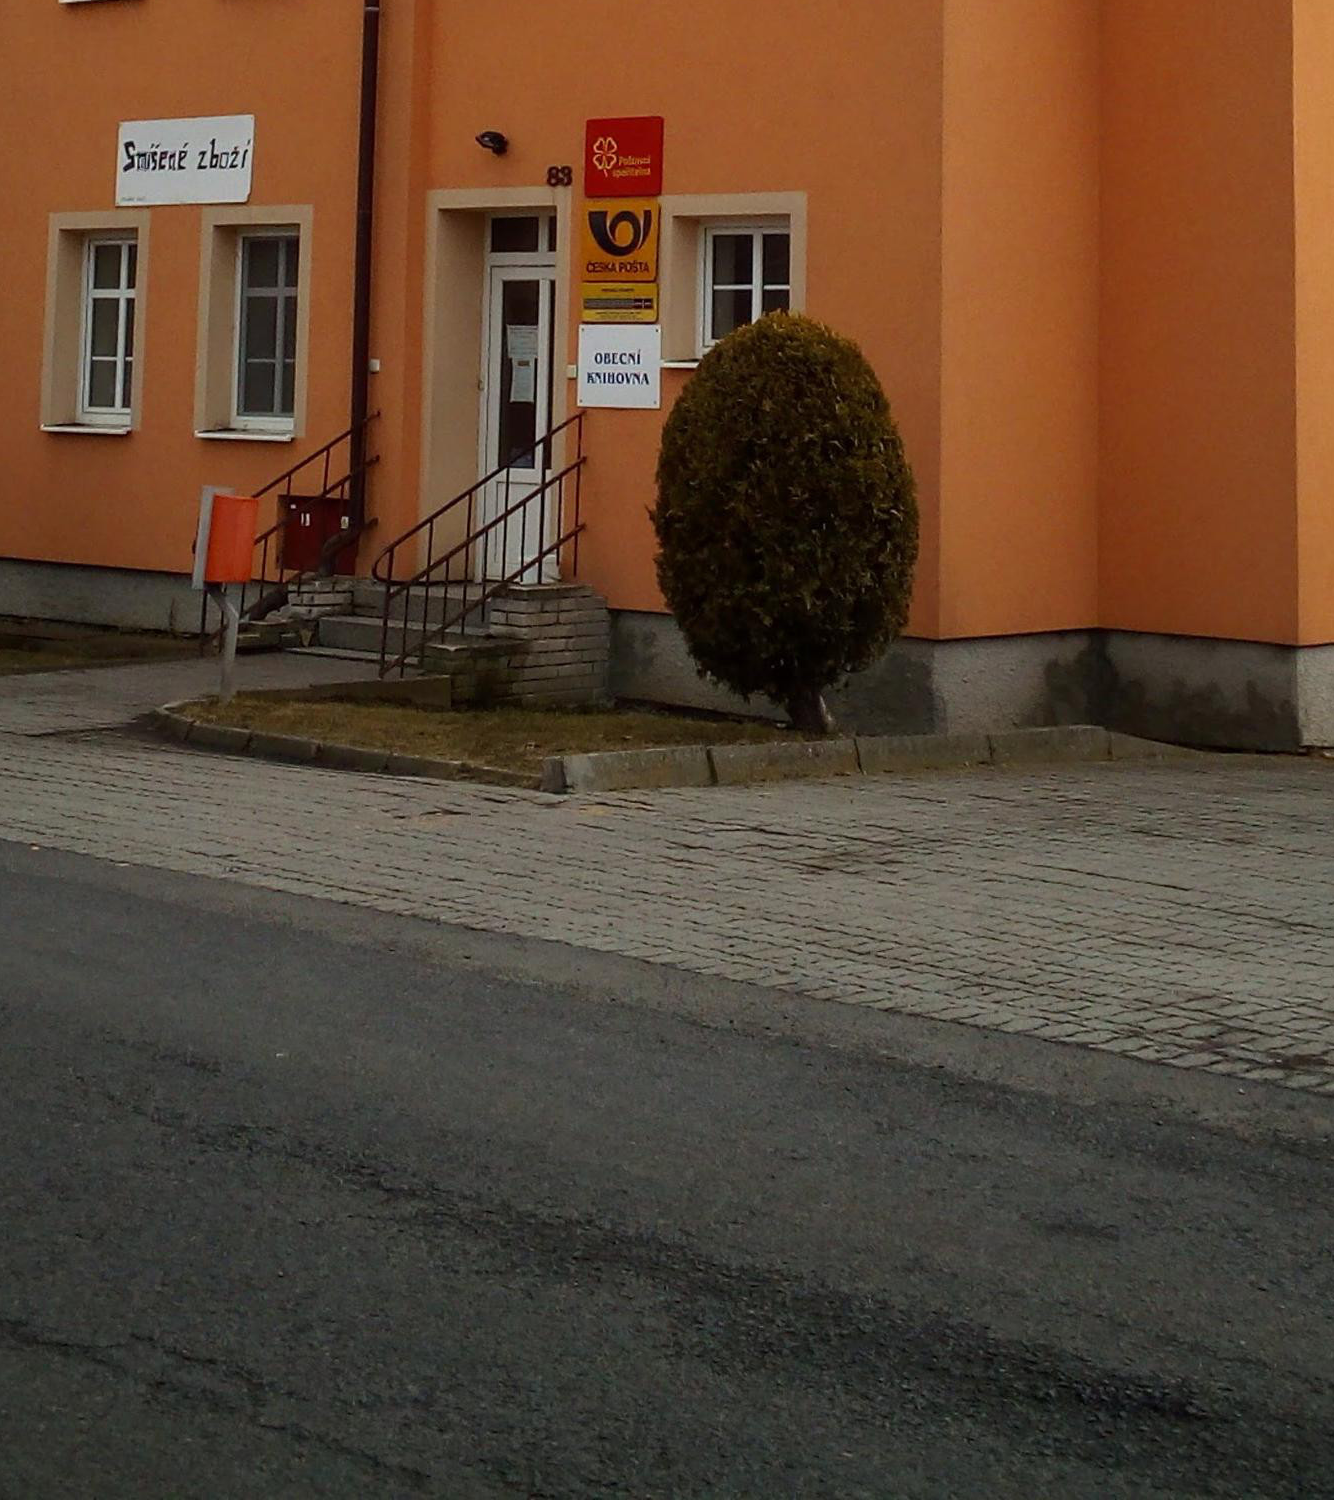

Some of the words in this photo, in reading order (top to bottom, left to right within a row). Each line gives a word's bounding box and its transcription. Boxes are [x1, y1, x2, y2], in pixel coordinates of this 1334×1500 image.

[197, 138, 251, 169] zboží
[618, 260, 649, 273] POŠTA
[594, 349, 641, 365] OBECNÍ
[587, 372, 649, 385] KNIHOVNA
